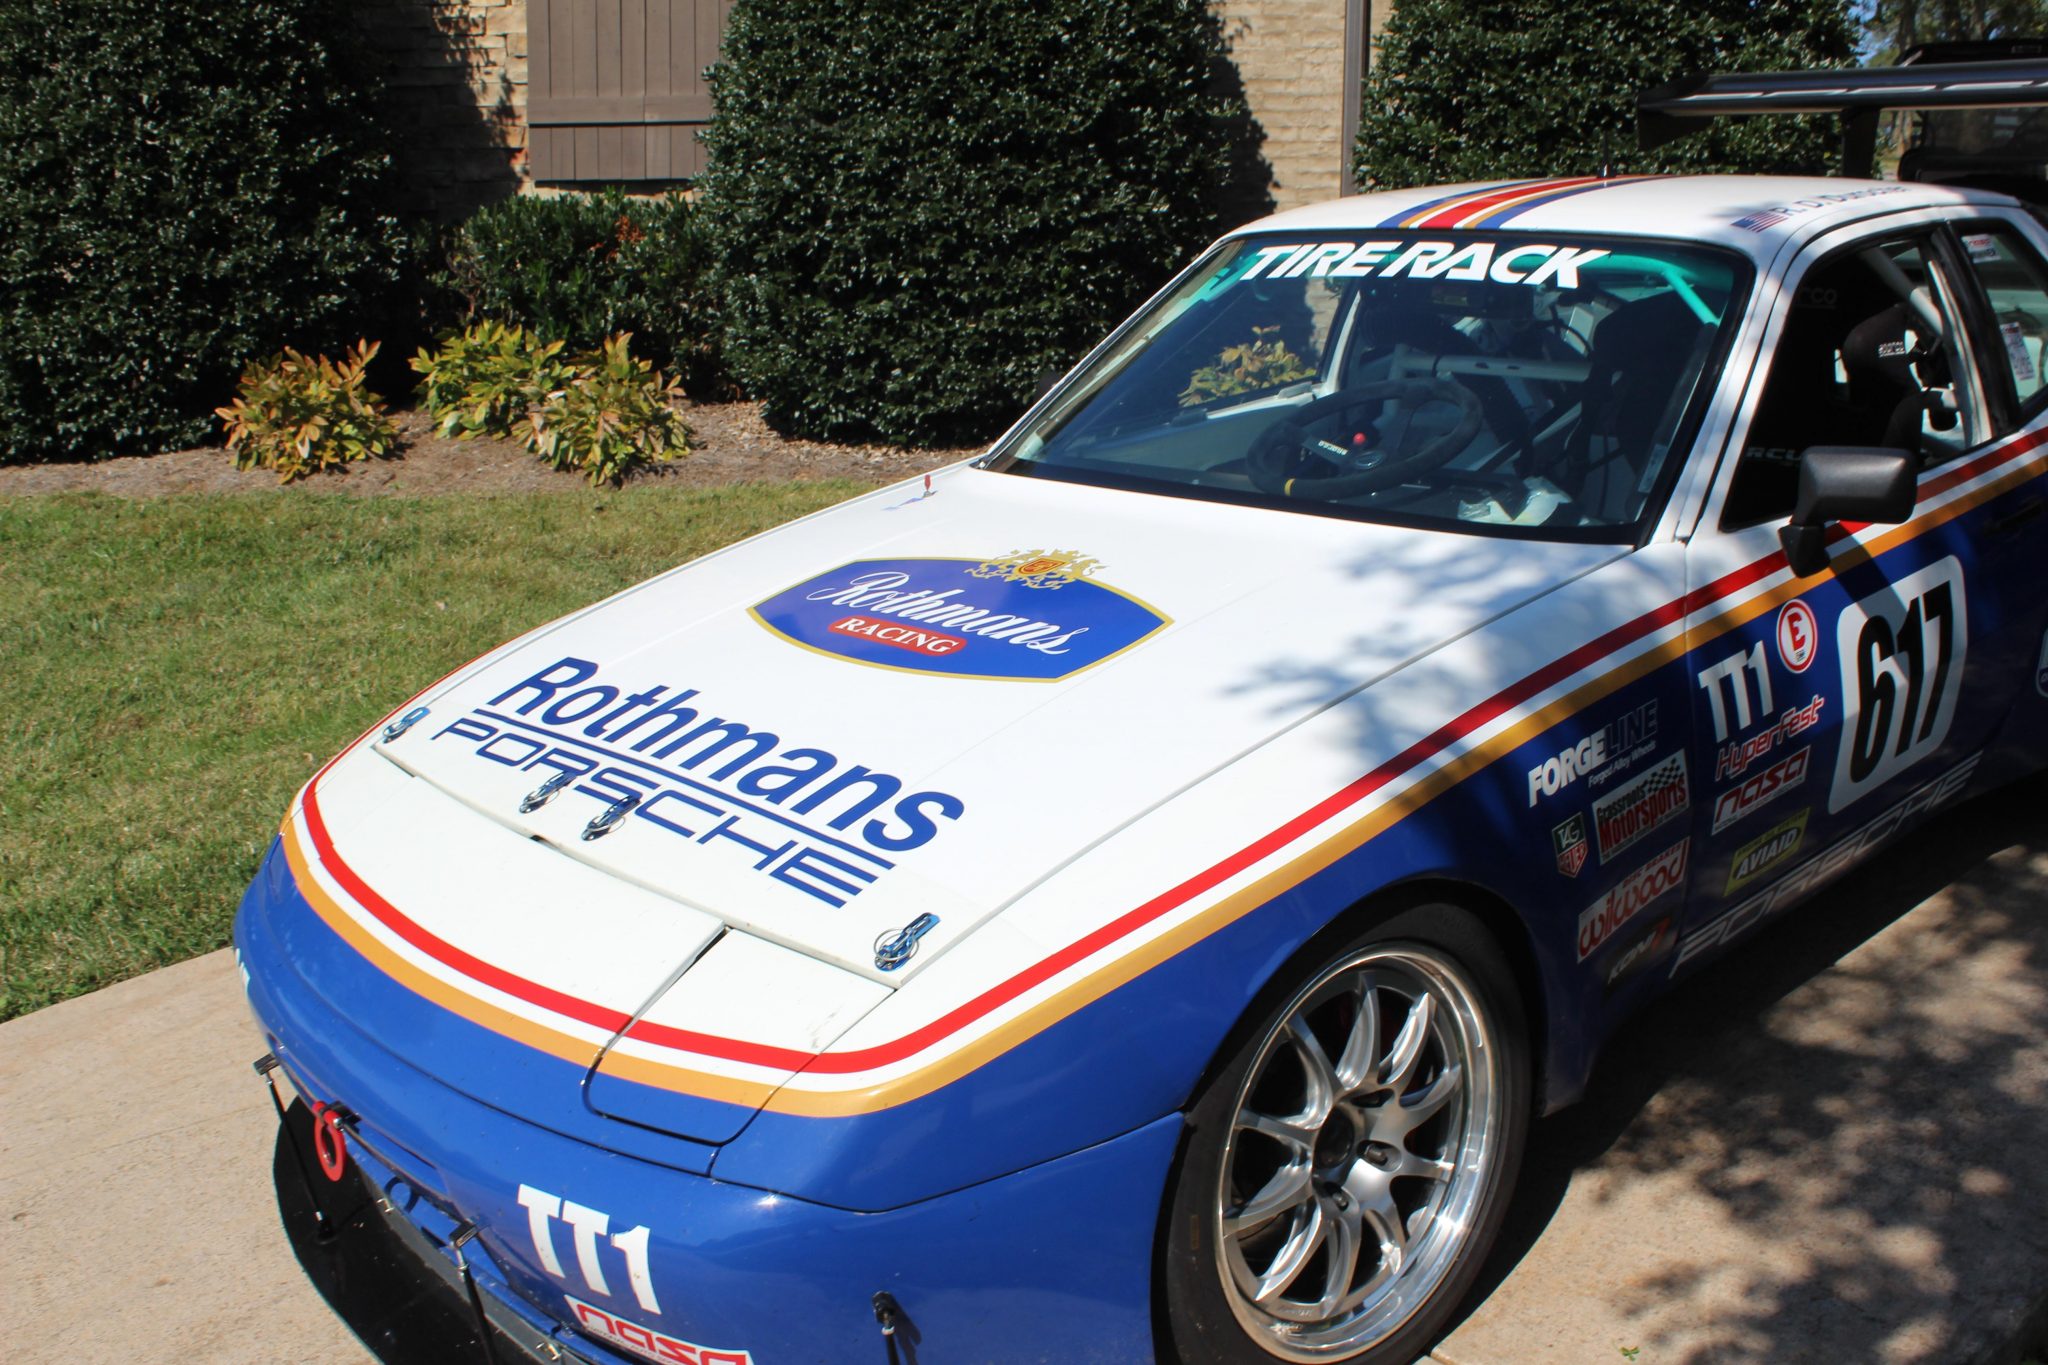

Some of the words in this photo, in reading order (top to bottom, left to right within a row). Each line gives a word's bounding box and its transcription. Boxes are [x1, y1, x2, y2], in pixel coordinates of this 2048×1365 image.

[806, 571, 1090, 655] Rothmans
[834, 614, 960, 654] RACING
[1697, 639, 1775, 744] TT1
[1850, 580, 1953, 784] 617
[486, 656, 965, 852] Rothmans
[430, 717, 879, 909] PORSCHE
[1556, 820, 1582, 848] TAG
[1598, 774, 1687, 853] Motorsports
[1734, 827, 1799, 881] AVIAID
[1579, 838, 1688, 958] wilwood
[517, 1183, 663, 1315] TT1
